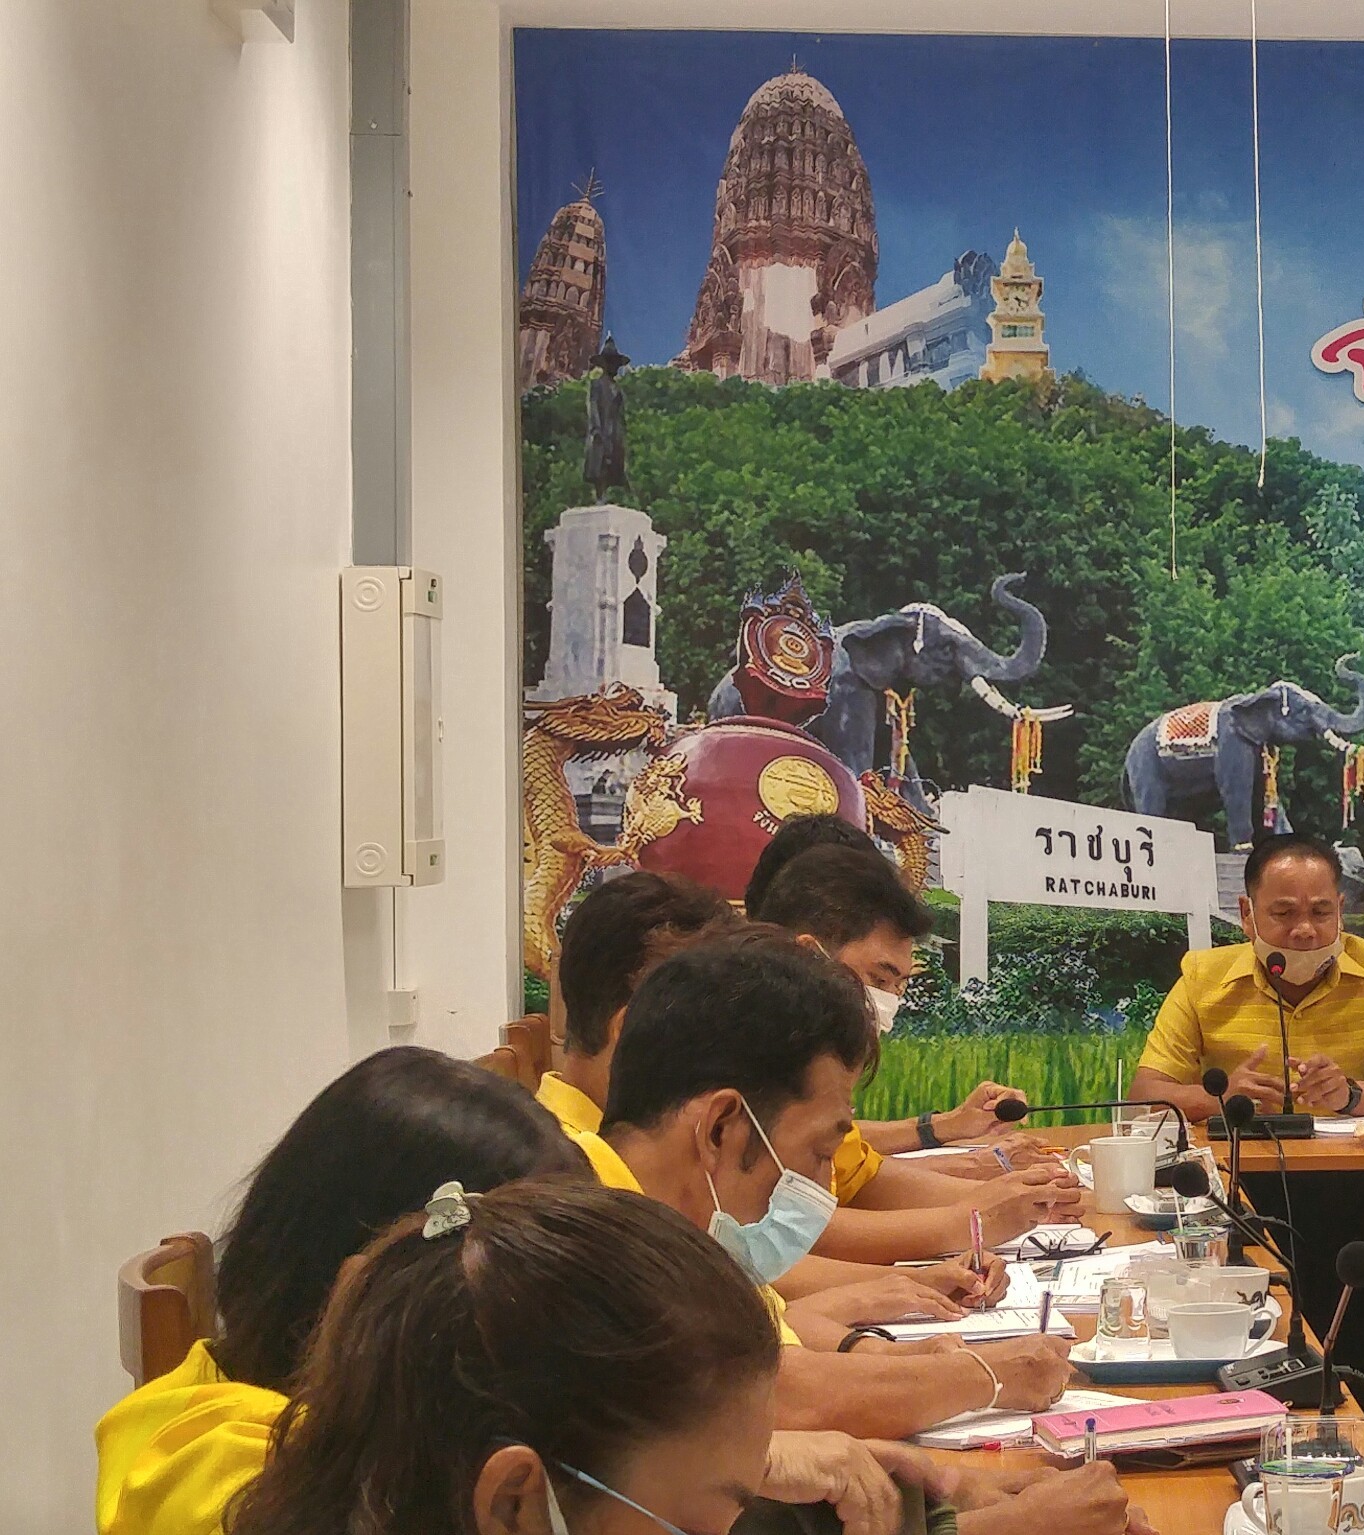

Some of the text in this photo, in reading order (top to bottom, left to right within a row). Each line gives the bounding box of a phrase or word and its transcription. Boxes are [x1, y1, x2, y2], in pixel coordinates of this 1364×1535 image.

[1035, 824, 1155, 883] ราชบุรี
[1045, 876, 1156, 901] RATCHABURI
